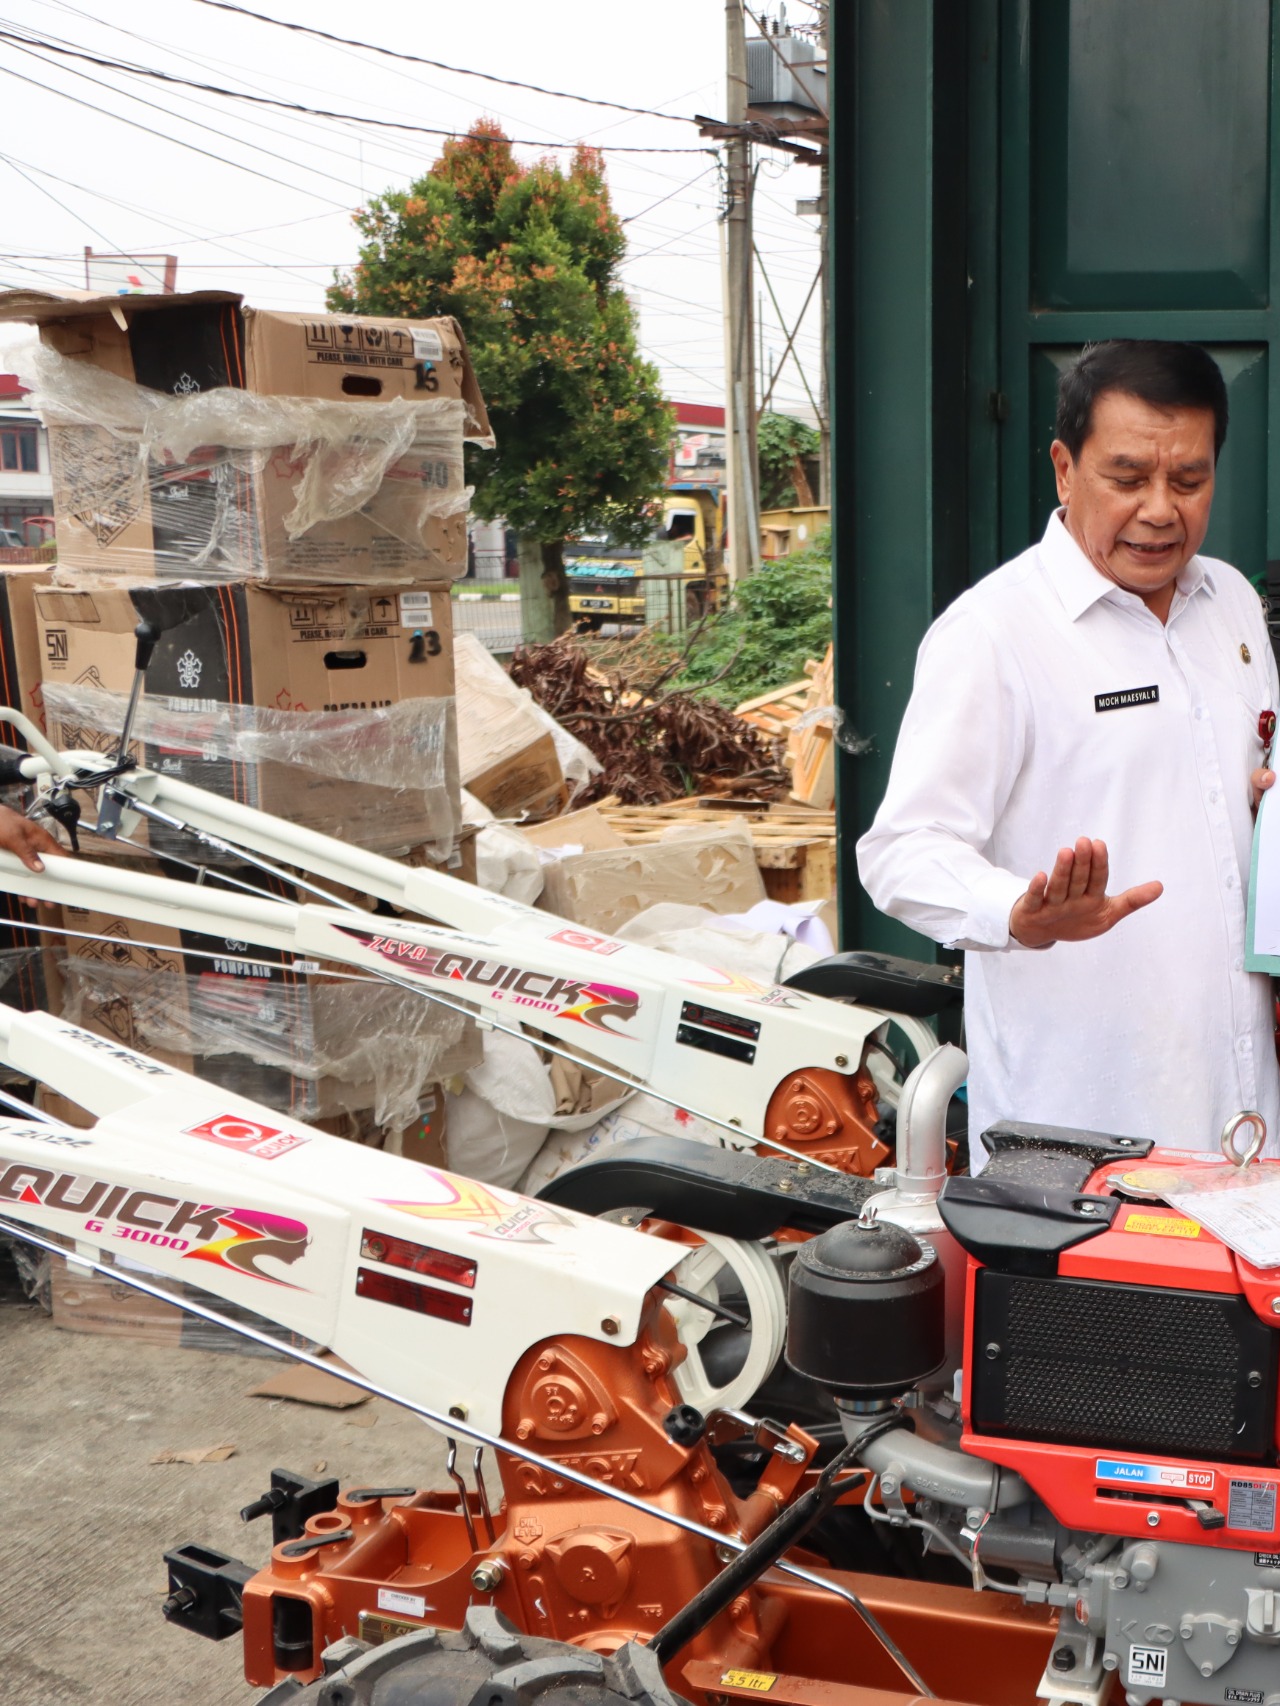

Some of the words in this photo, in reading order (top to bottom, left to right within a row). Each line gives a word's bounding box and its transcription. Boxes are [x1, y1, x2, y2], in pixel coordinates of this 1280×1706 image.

[317, 352, 343, 363] PLEASE,
[369, 354, 386, 365] WITH
[387, 356, 403, 367] CARE
[300, 629, 325, 640] PLEASE,
[370, 626, 388, 637] CARE
[46, 632, 68, 659] SNI
[1098, 696, 1119, 708] MOCH
[1120, 691, 1150, 704] MAESYAL
[1151, 690, 1157, 699] R
[367, 936, 428, 961] ZEVA
[213, 959, 251, 976] POMPA
[252, 964, 273, 978] AIR
[432, 952, 590, 1006] QUICK
[491, 990, 504, 1001] G
[508, 992, 560, 1014] 3000
[255, 1132, 304, 1157] QUICK
[0, 1164, 234, 1242] QUICK
[494, 1205, 537, 1236] QUICK
[84, 1219, 105, 1233] G
[111, 1225, 190, 1251] 3000
[1113, 1466, 1144, 1478] JALAN
[1188, 1474, 1211, 1485] STOP
[1131, 1651, 1165, 1672] SNI
